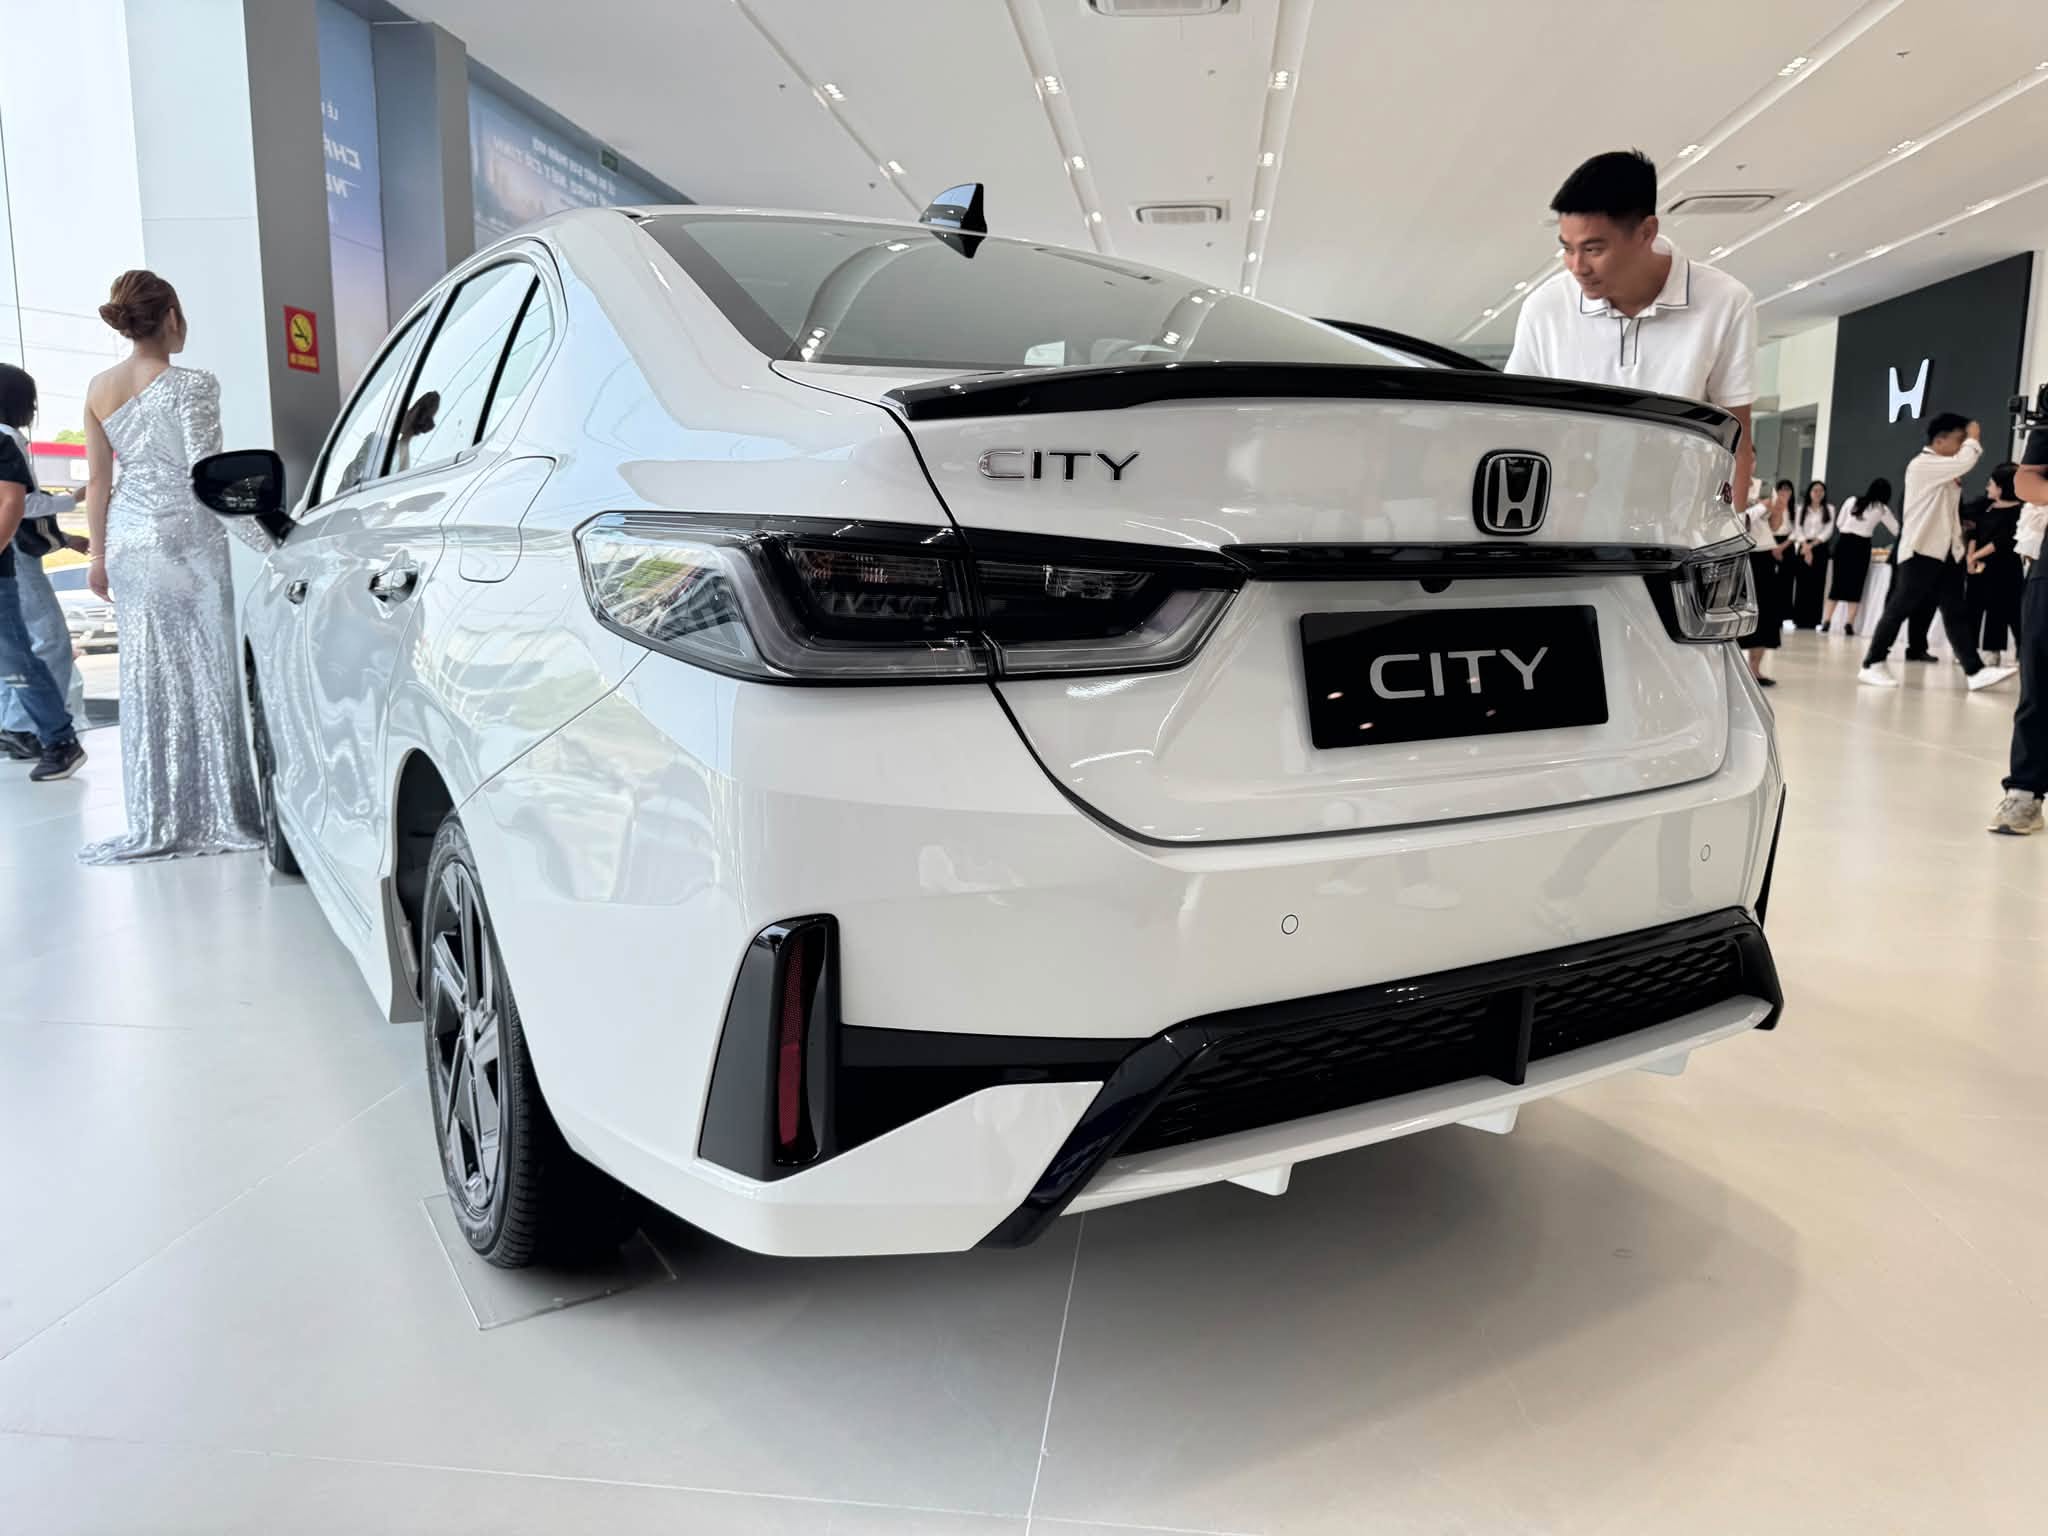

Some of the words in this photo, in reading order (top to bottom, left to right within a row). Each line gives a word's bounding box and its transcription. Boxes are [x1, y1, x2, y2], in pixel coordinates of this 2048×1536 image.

[1888, 358, 1930, 424] H
[977, 449, 1141, 481] CITY
[1496, 459, 1541, 528] H
[1369, 646, 1549, 700] CITY
